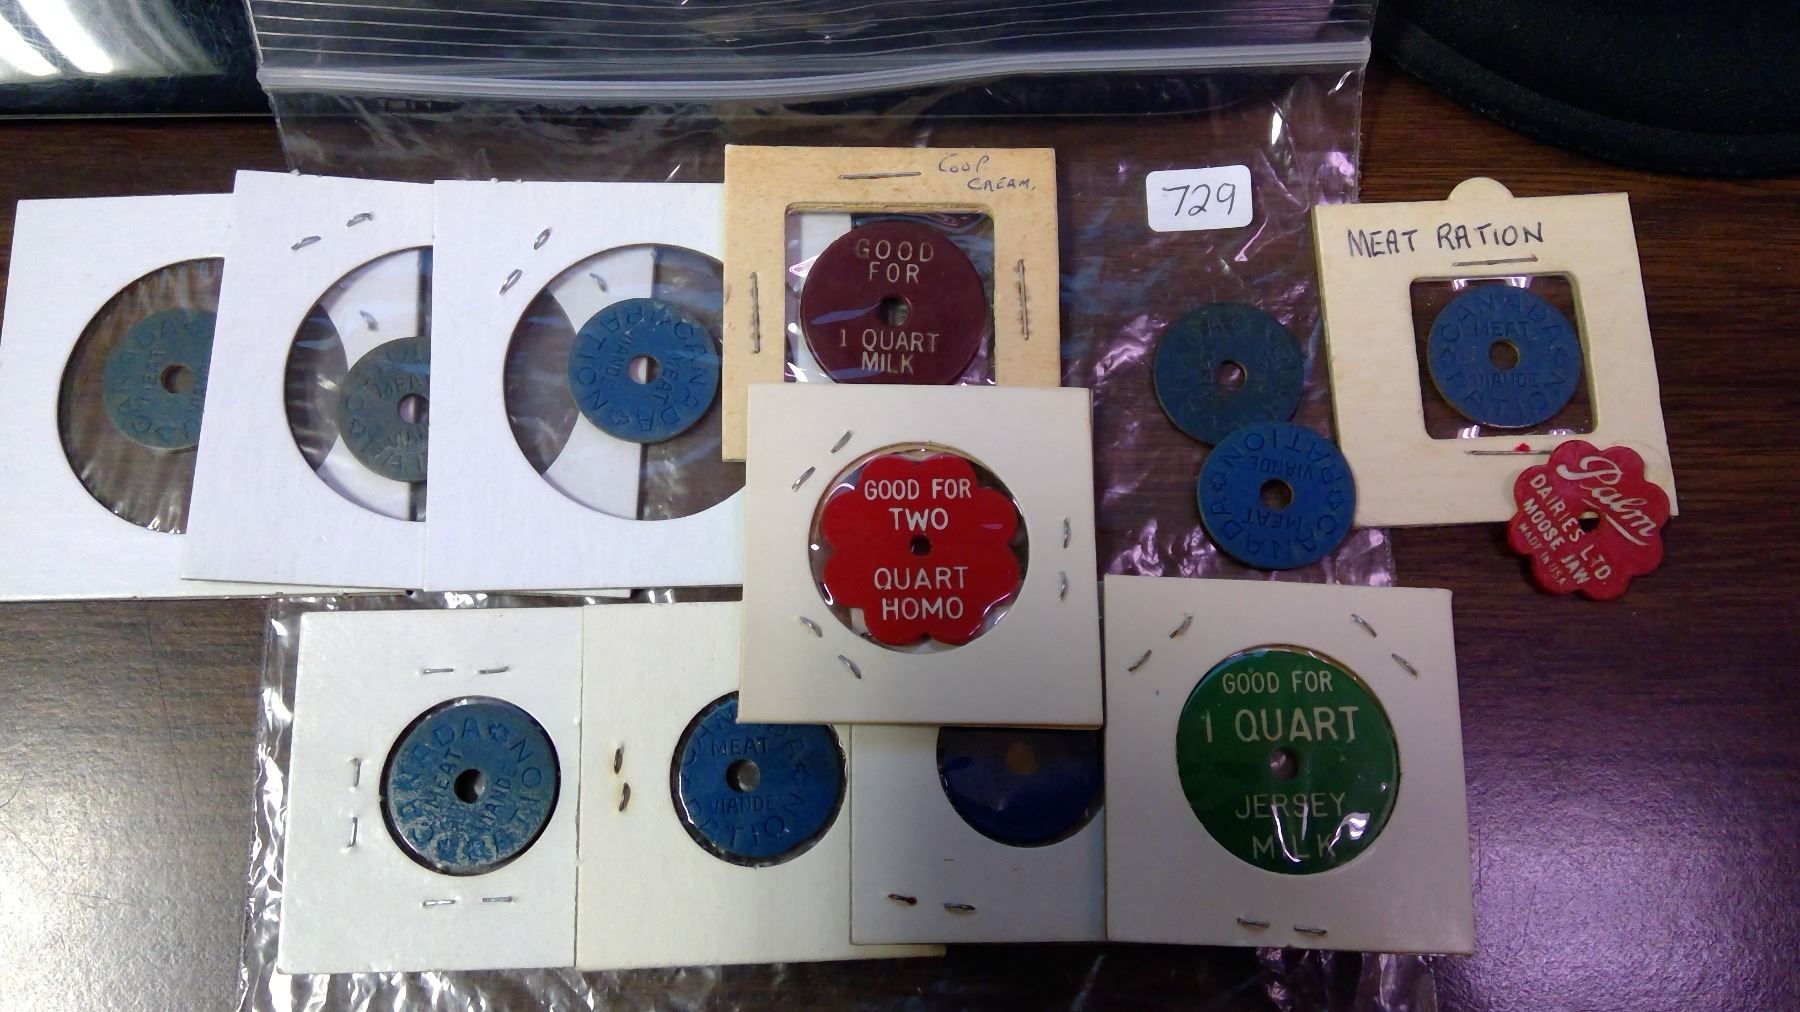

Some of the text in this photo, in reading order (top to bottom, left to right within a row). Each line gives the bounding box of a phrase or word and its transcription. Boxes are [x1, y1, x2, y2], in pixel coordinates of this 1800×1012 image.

[1162, 183, 1235, 216] 729
[855, 239, 934, 262] GOOD
[1347, 222, 1544, 258] MEAT RATION
[869, 262, 920, 283] FOR
[1442, 293, 1564, 343] CANADA
[1474, 320, 1530, 337] MEAT
[839, 328, 940, 352] 1 QUART
[576, 305, 643, 411] RATION
[861, 352, 914, 374] MILK
[636, 322, 708, 432] CANADA
[653, 356, 684, 404] MEAT
[1221, 429, 1343, 485] RATION
[1251, 456, 1312, 480] VIANDE
[864, 478, 972, 500] GOOD FOR
[1556, 456, 1657, 538] Palm
[888, 508, 948, 531] TWO
[1241, 507, 1299, 530] MEAT
[1530, 474, 1586, 543] DAIRIES
[1211, 504, 1337, 559] CANADA
[1519, 522, 1543, 549] MADE
[1523, 498, 1591, 585] MOOSE JAW
[874, 566, 968, 590] QUART
[882, 597, 963, 620] HOMO
[1222, 670, 1333, 694] GOOD FOR
[1201, 706, 1359, 743] 1 QUART
[711, 737, 768, 757] MEAT
[711, 794, 776, 815] VIANDE
[1235, 791, 1345, 819] JERSEY
